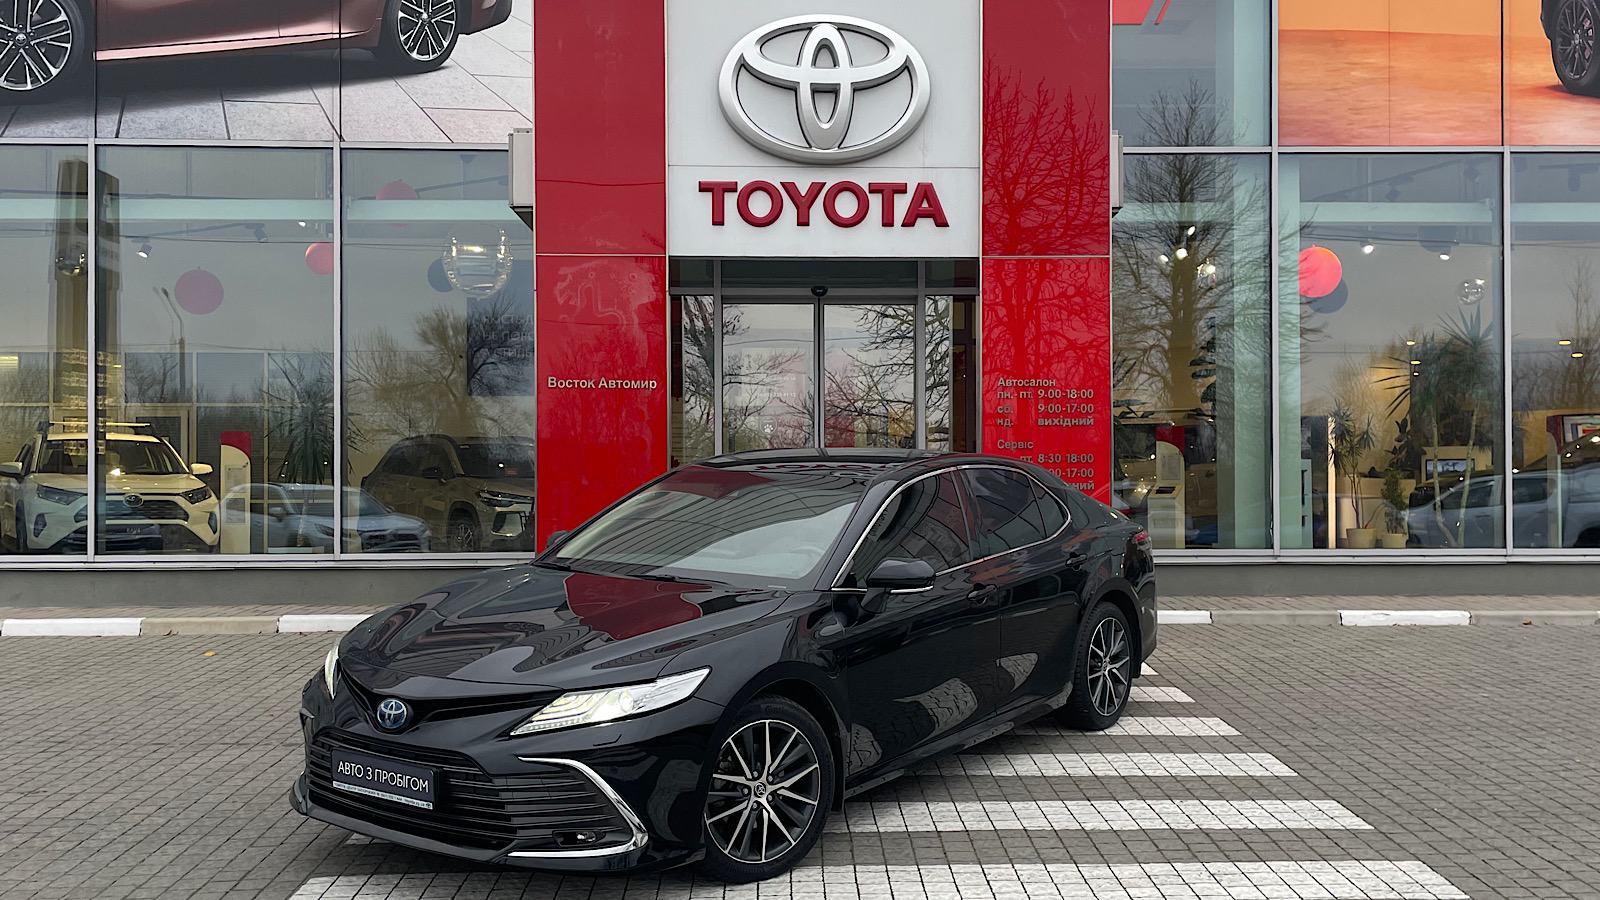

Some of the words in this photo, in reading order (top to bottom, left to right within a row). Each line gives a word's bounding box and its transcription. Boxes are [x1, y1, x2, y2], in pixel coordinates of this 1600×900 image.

[698, 180, 950, 228] TOYOTA
[547, 376, 596, 389] Восток
[598, 377, 657, 391] Автомир
[997, 377, 1056, 387] Автосалон
[997, 404, 1014, 413] сб.
[1038, 403, 1094, 413] 9:00-17:00
[997, 418, 1014, 427] нд.
[1038, 416, 1094, 427] вихідний
[997, 439, 1034, 451] Сервіс
[1038, 453, 1062, 463] 8:30
[1066, 453, 1094, 463] 18:00
[337, 760, 364, 778] АВТО
[366, 766, 373, 780] З
[375, 768, 429, 793] ПРОБІГОМ
